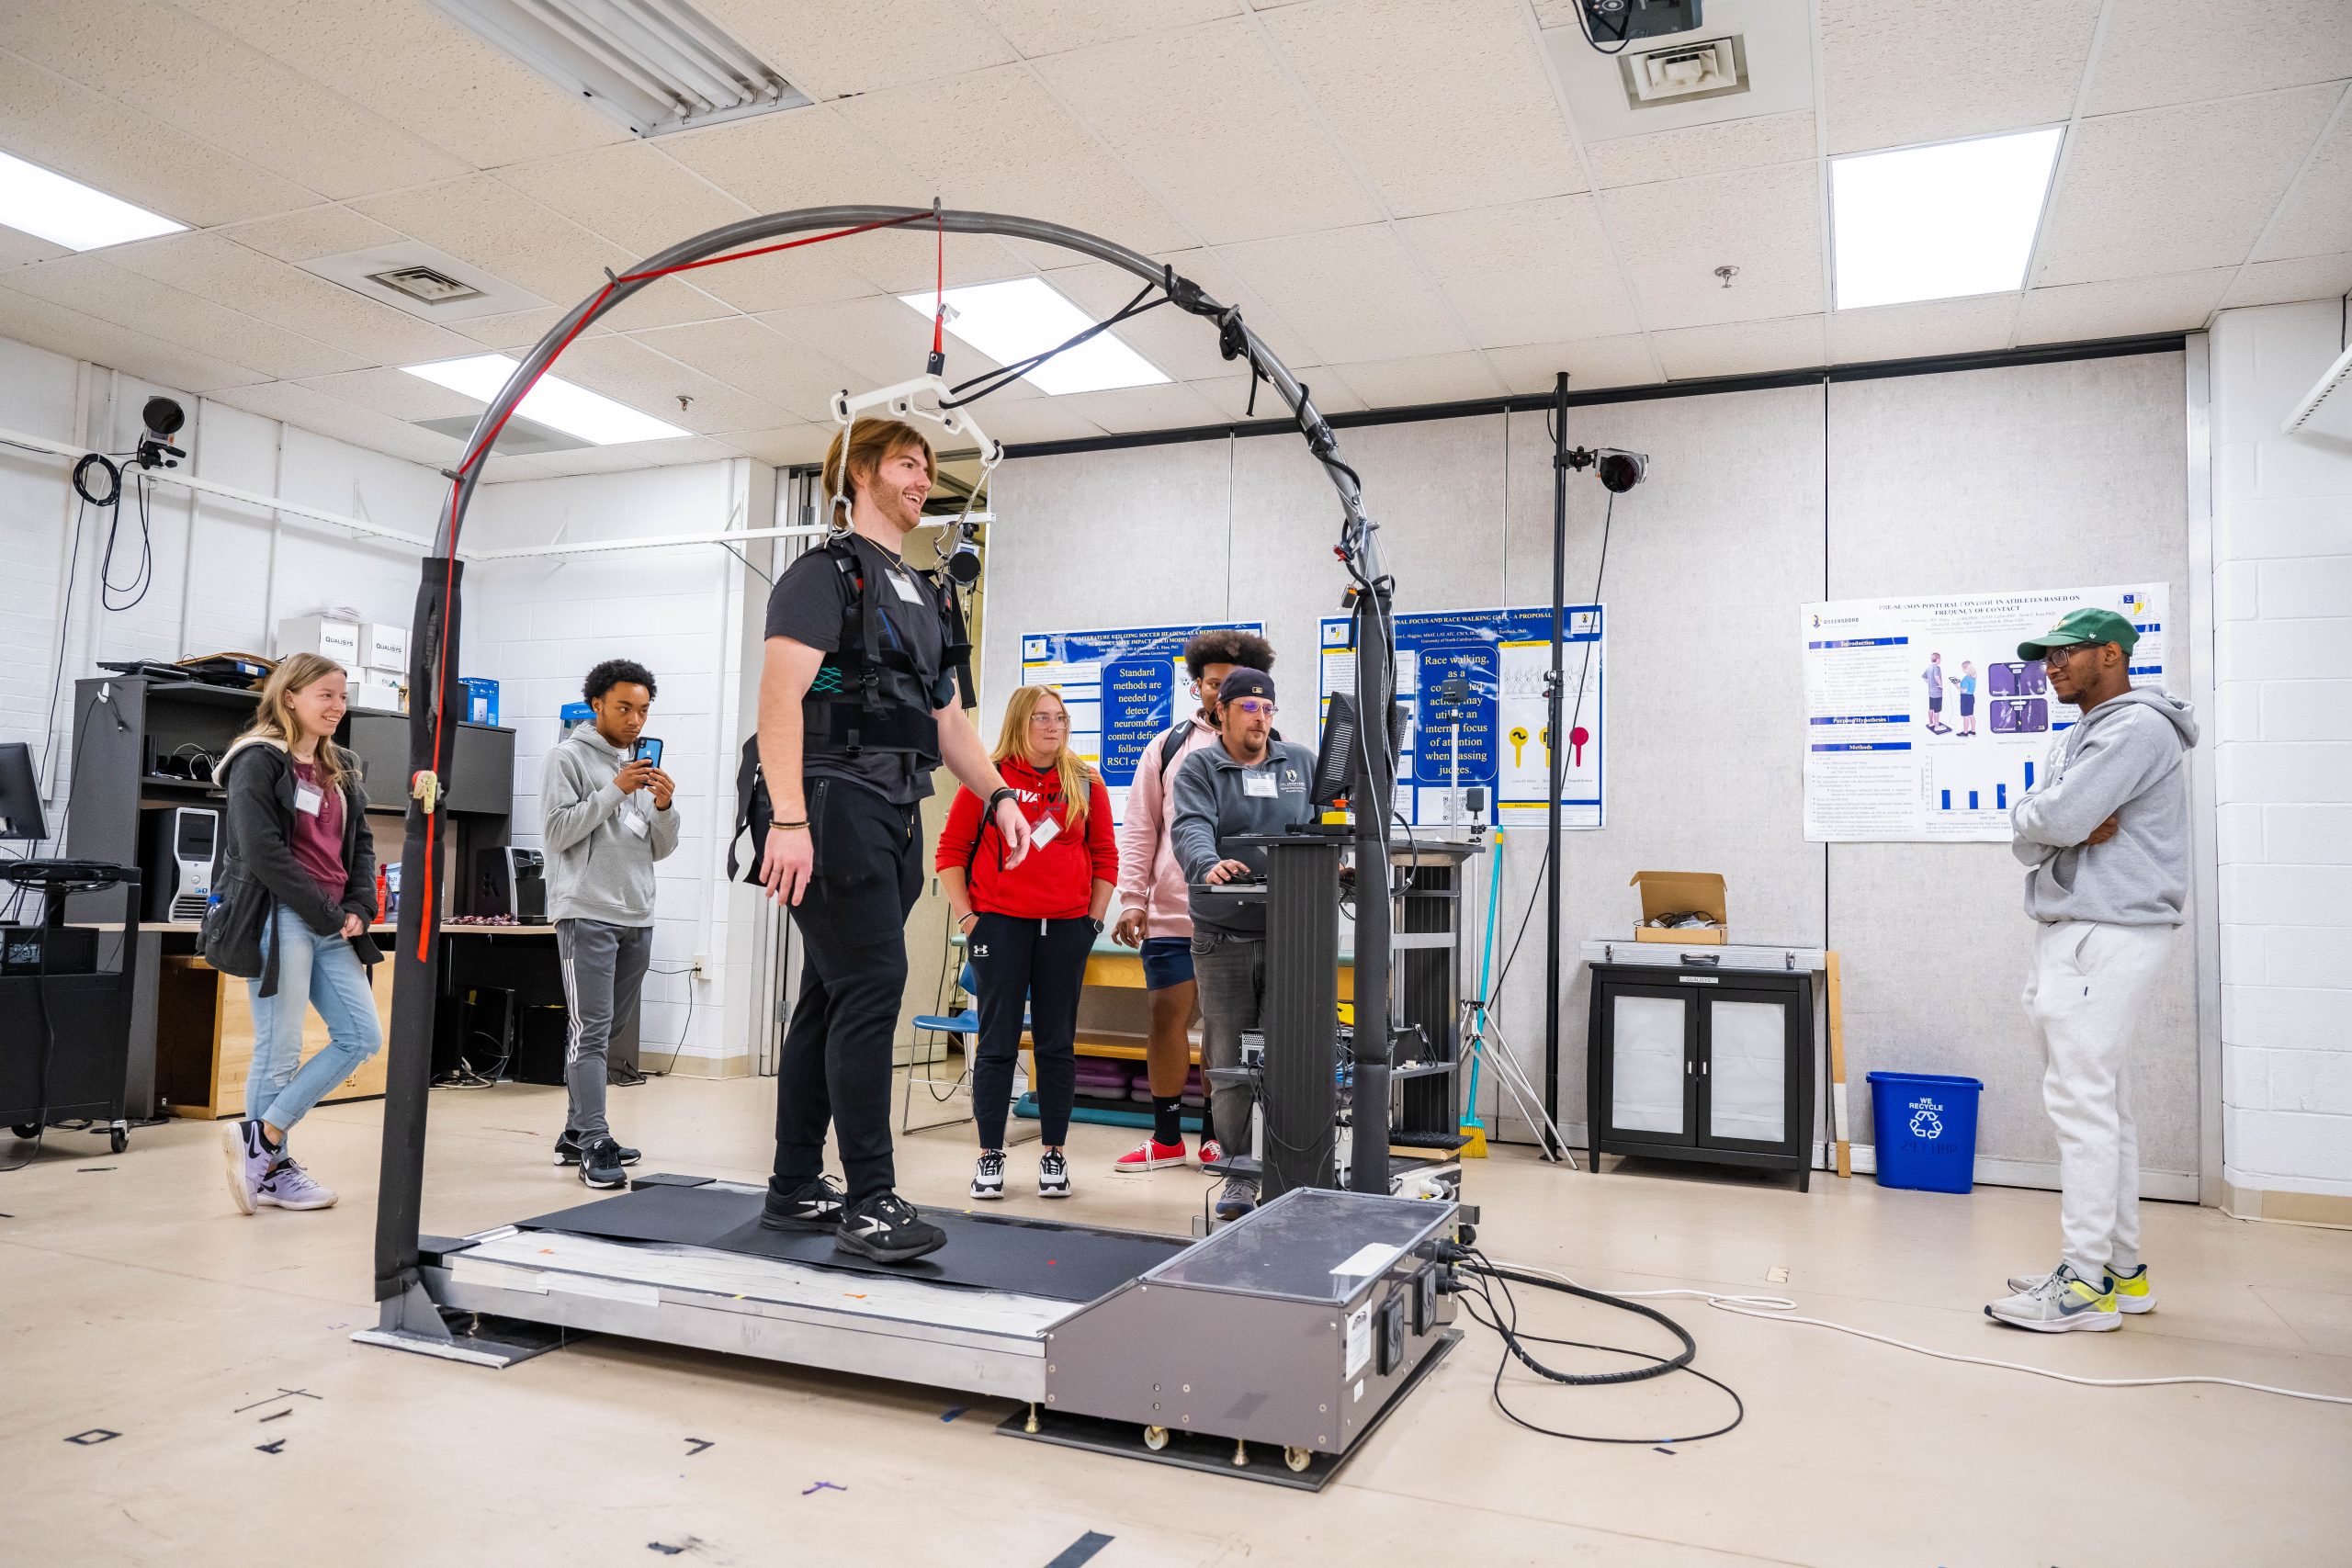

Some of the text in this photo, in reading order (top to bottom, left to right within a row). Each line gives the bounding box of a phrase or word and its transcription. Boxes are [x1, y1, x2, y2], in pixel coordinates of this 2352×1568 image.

[325, 636, 354, 647] QUALISYS
[376, 642, 402, 653] QUALISYS
[1425, 654, 1489, 665] Race walking,
[1119, 667, 1156, 677] Standard
[1460, 670, 1465, 678] a
[1113, 681, 1148, 690] methods
[1118, 694, 1157, 703] needed to
[1125, 706, 1149, 715] detect
[1114, 719, 1159, 728] neuromotor
[1425, 723, 1488, 733] internl focus
[1107, 731, 1136, 740] control
[1430, 737, 1483, 747] of atntion
[1118, 744, 1147, 753] followi
[1425, 750, 1487, 761] when assing
[1107, 758, 1140, 766] RSCI ex
[1908, 1102, 1944, 1111] RECYCLE
